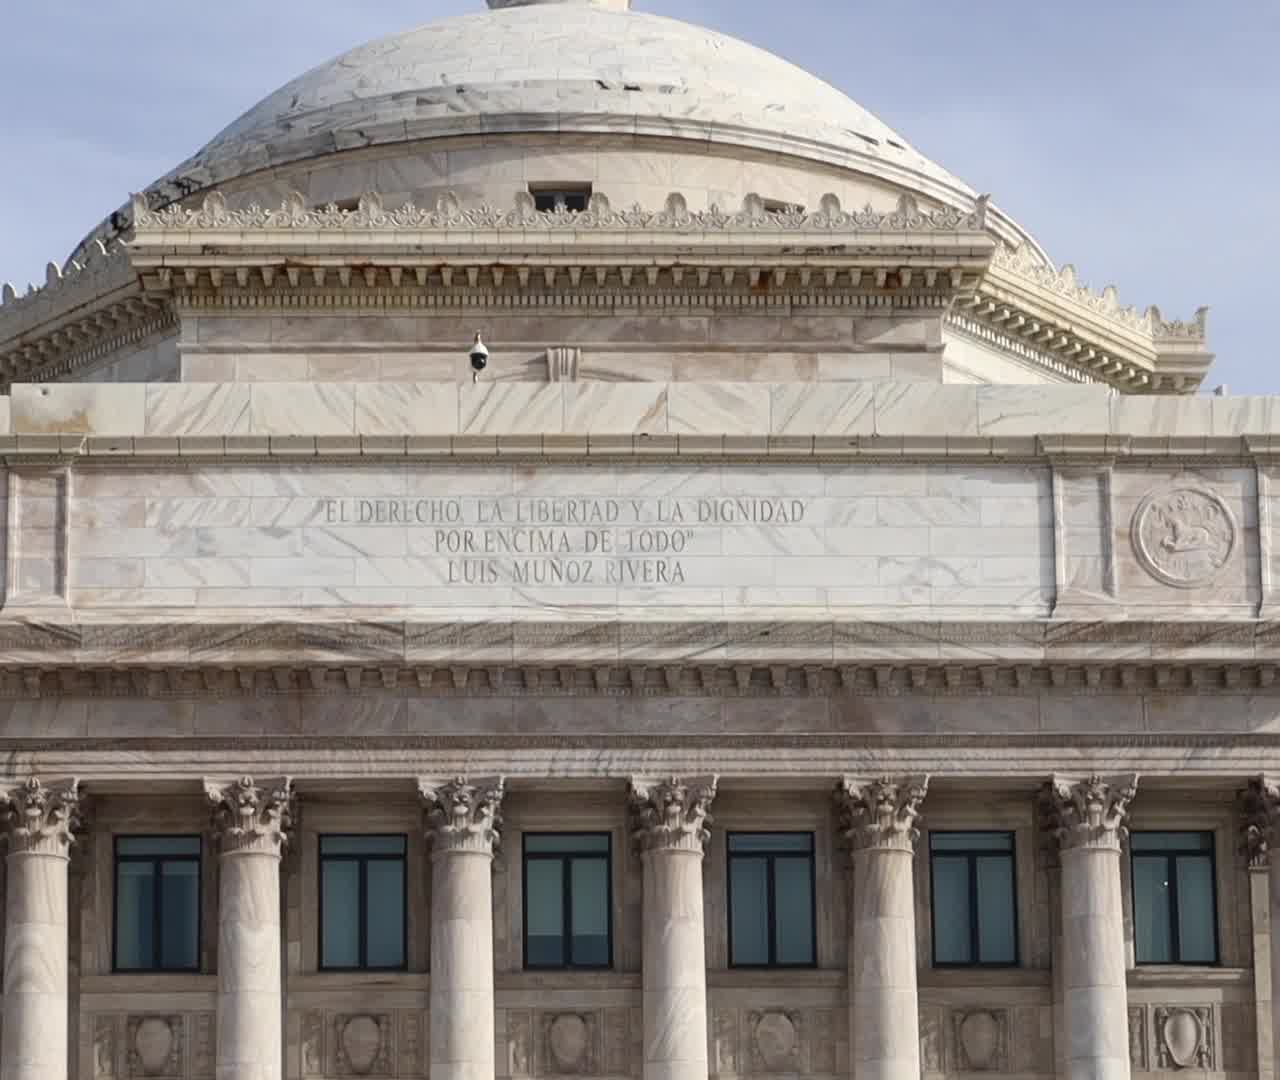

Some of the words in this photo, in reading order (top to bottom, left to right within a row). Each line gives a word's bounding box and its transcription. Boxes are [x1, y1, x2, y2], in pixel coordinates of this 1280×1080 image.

[477, 500, 504, 522] LA
[516, 500, 619, 522] LIBERTAD
[630, 500, 643, 522] Y
[656, 500, 684, 522] LA
[697, 500, 805, 522] DIGNIDAD
[435, 530, 476, 553] POR
[484, 530, 570, 553] ENCIMA
[585, 530, 611, 553] DE
[625, 529, 694, 553] TODO"
[447, 559, 498, 584] LUIS
[605, 559, 685, 584] RIVERA
